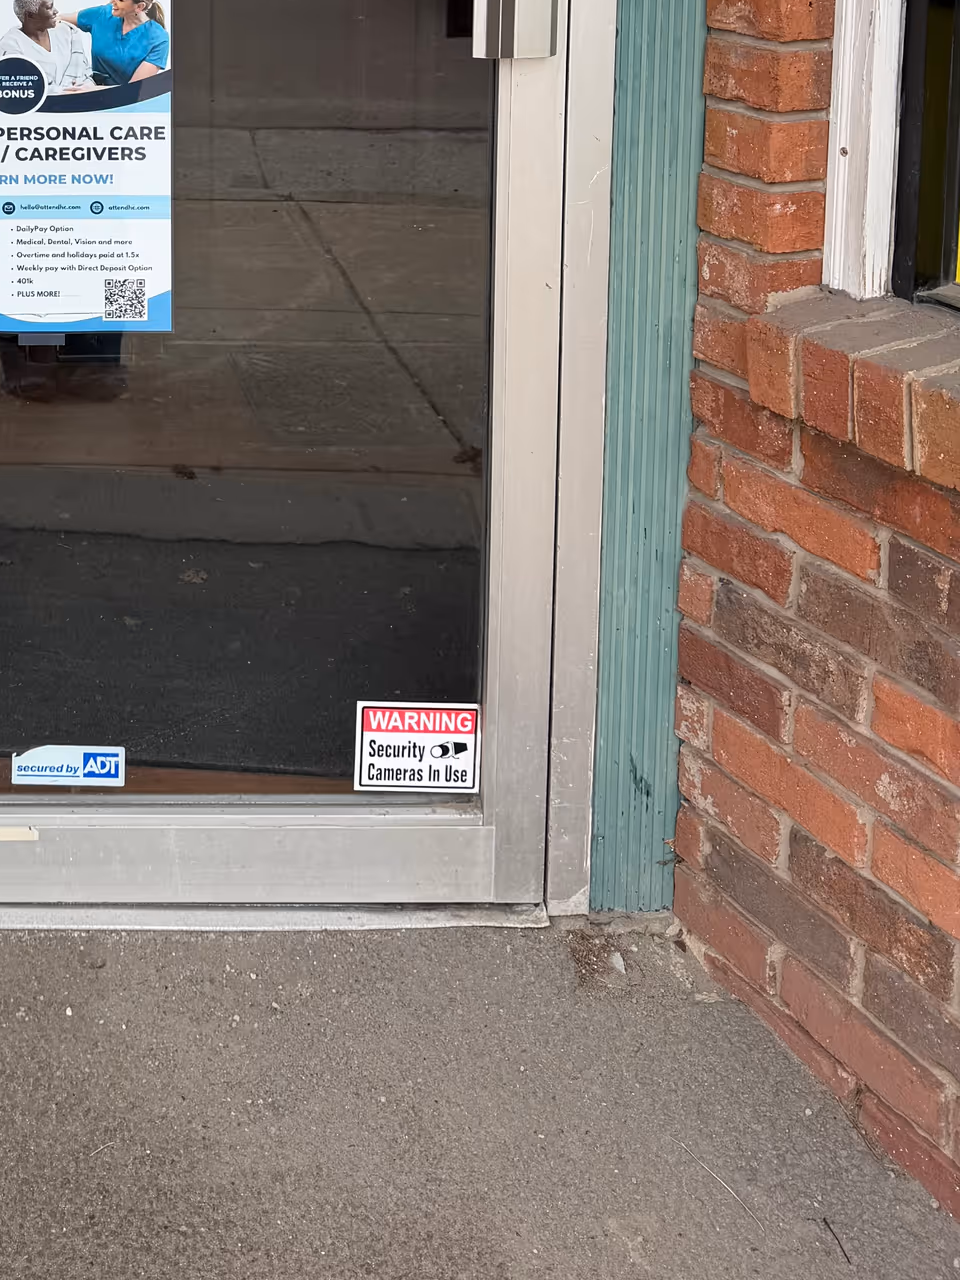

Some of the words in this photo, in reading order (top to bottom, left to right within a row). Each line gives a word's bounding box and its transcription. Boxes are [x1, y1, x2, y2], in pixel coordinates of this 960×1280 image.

[109, 126, 166, 141] CARE
[0, 145, 10, 163] /
[15, 146, 147, 162] CAREGIVERS
[23, 174, 67, 185] MORE
[71, 174, 114, 185] NOW!
[16, 238, 46, 246] Medical,
[47, 238, 73, 246] Dental,
[369, 711, 472, 732] WARNING
[369, 739, 425, 762] Security
[16, 764, 64, 773] secured
[65, 764, 80, 774] by
[83, 756, 120, 775] ADT
[368, 763, 424, 782] Cameras
[428, 764, 440, 782] In
[444, 765, 468, 782] Use
